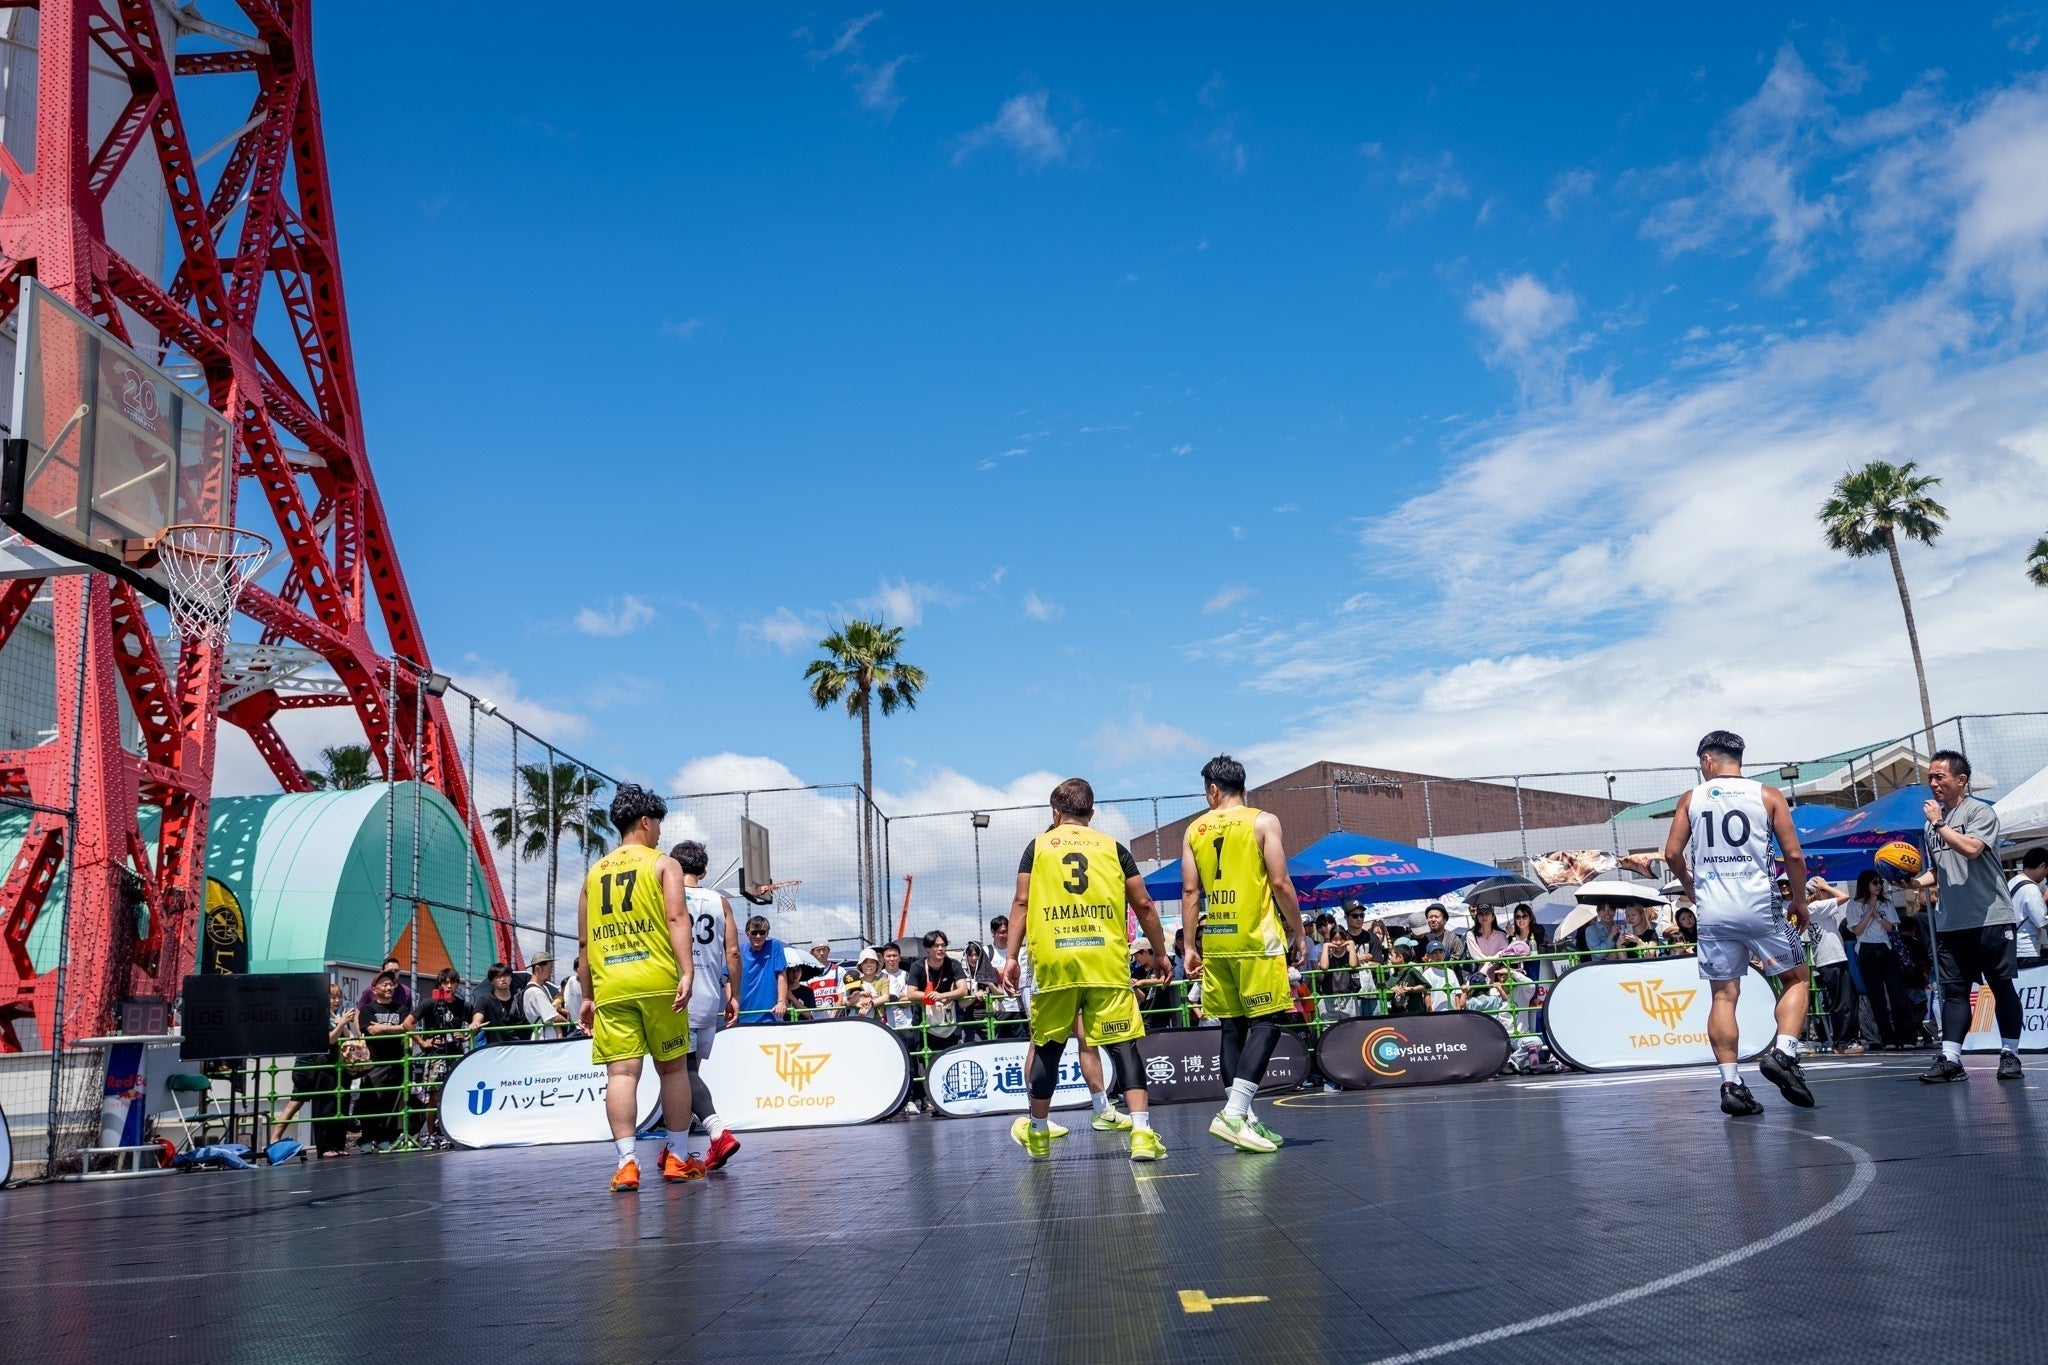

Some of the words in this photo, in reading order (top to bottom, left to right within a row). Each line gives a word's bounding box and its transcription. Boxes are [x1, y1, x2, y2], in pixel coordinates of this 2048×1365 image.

[123, 368, 158, 421] 20
[1701, 809, 1751, 848] 10
[1213, 836, 1225, 880] 1
[1703, 855, 1753, 864] MATSUMOTO
[1061, 852, 1089, 895] 3
[1372, 863, 1421, 876] Bull
[600, 869, 638, 916] 17
[1207, 890, 1236, 905] NDO
[1043, 904, 1114, 921] YAMAMOTO
[592, 918, 656, 942] MORIYAMA
[1629, 1034, 1661, 1048] TAD
[1385, 1043, 1432, 1057] Bayside
[1435, 1042, 1468, 1053] Place
[1410, 1054, 1449, 1063] HAKATA
[524, 1077, 533, 1086] U
[534, 1076, 562, 1085] Happy
[568, 1071, 605, 1081] UEMURA
[1184, 1074, 1221, 1083] HAKAT
[1266, 1069, 1291, 1077] ICHI
[755, 1096, 785, 1109] TAD
[787, 1094, 836, 1108] Group
